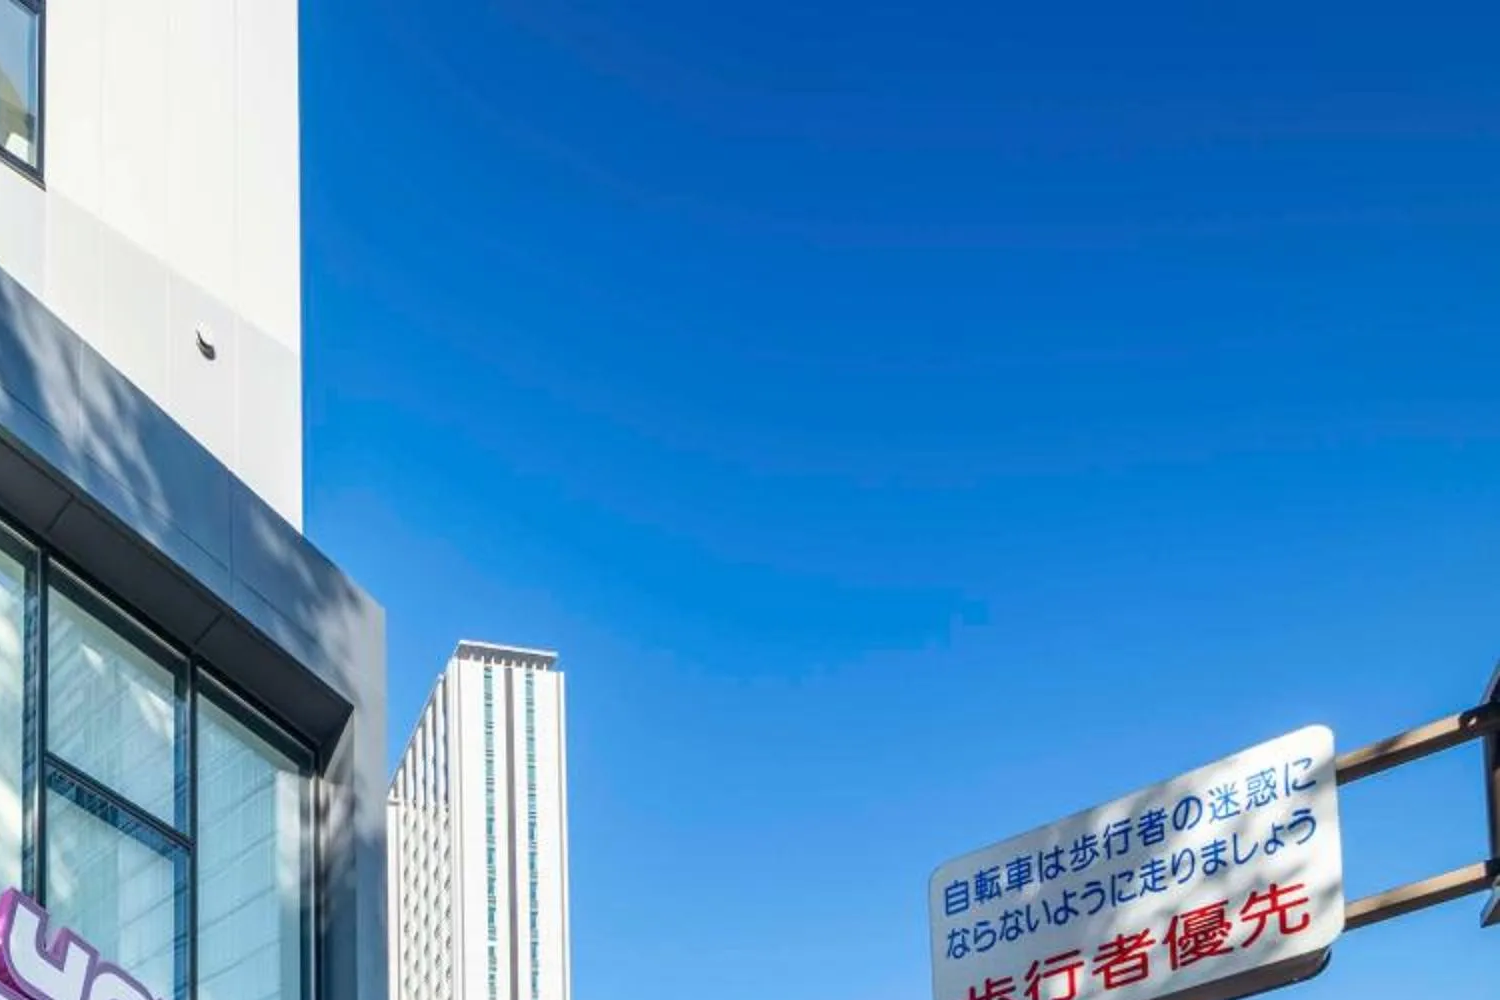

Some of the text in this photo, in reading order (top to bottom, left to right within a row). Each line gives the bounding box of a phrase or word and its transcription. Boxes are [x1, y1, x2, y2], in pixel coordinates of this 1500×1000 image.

[944, 757, 1317, 915] 自転車は歩行者の迷惑に
[946, 808, 1318, 959] ならないように走りましょう
